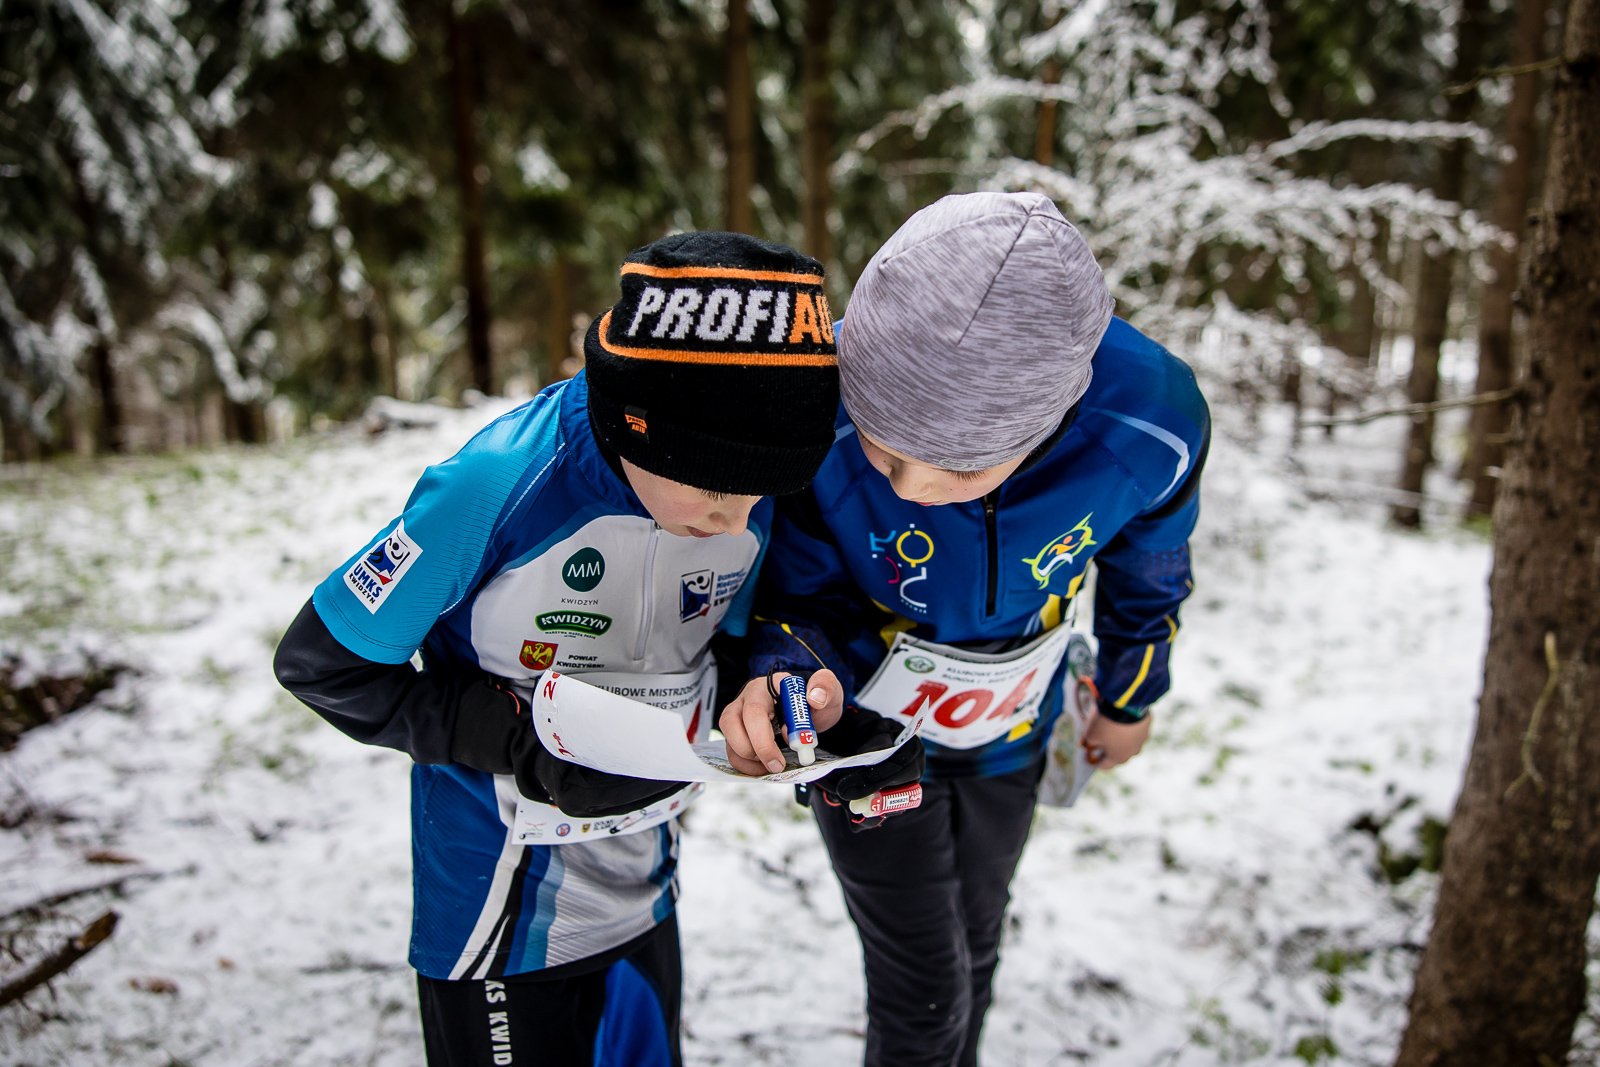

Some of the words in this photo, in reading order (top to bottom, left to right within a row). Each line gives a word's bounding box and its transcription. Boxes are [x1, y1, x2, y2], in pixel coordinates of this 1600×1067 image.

[567, 561, 600, 578] MM
[349, 573, 376, 604] KWIDZYN
[353, 563, 383, 598] UMKS
[561, 598, 599, 606] KWIDZYN
[541, 614, 608, 630] KWIDZYN
[556, 661, 605, 669] KWIDZYŃSKI
[484, 979, 507, 1004] KS
[488, 1011, 513, 1067] KWID
